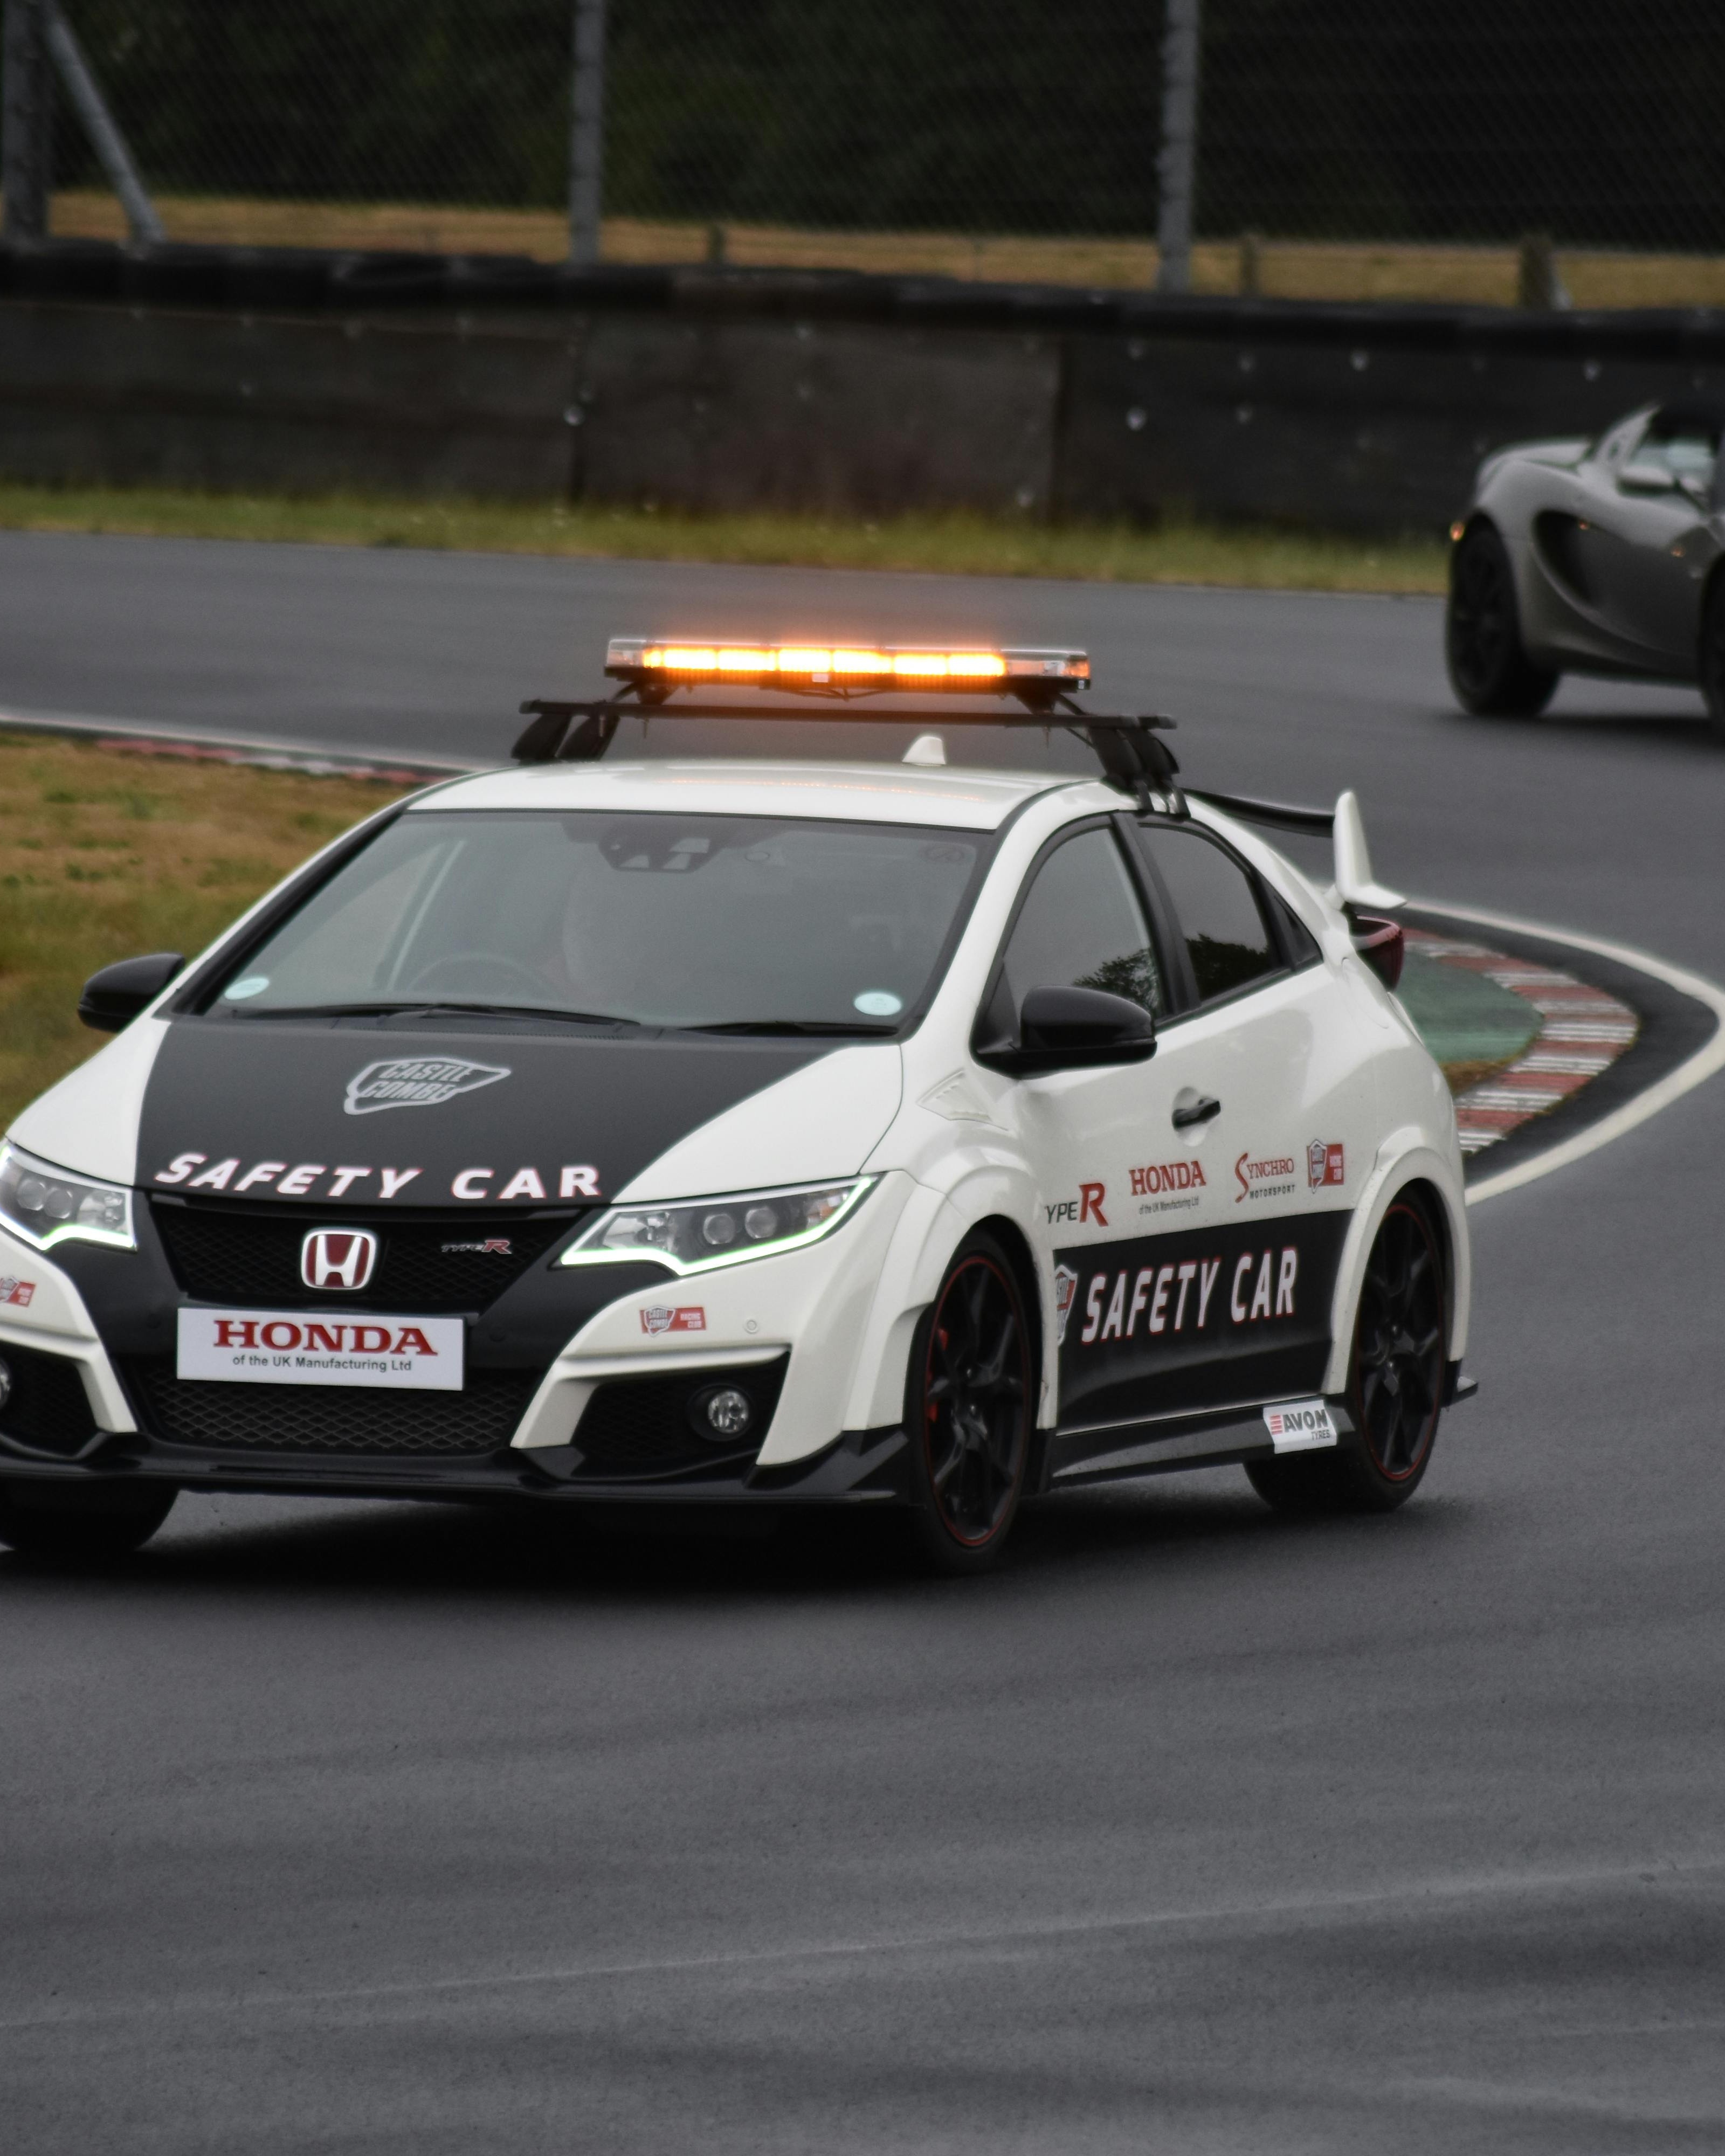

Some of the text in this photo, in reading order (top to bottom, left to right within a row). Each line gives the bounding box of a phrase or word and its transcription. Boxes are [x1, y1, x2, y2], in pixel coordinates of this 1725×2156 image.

[154, 1152, 601, 1200] SAFETY CAR
[1129, 1160, 1206, 1196] HONDA
[1249, 1185, 1295, 1199] MOTORSPORT
[1081, 1255, 1221, 1345] SAFETY
[1231, 1245, 1299, 1324] CAR
[212, 1320, 438, 1356] HONDA
[233, 1355, 412, 1373] of the UK Manufacturing Ltd
[1283, 1409, 1328, 1433] AVON
[1311, 1429, 1331, 1440] TYRES
